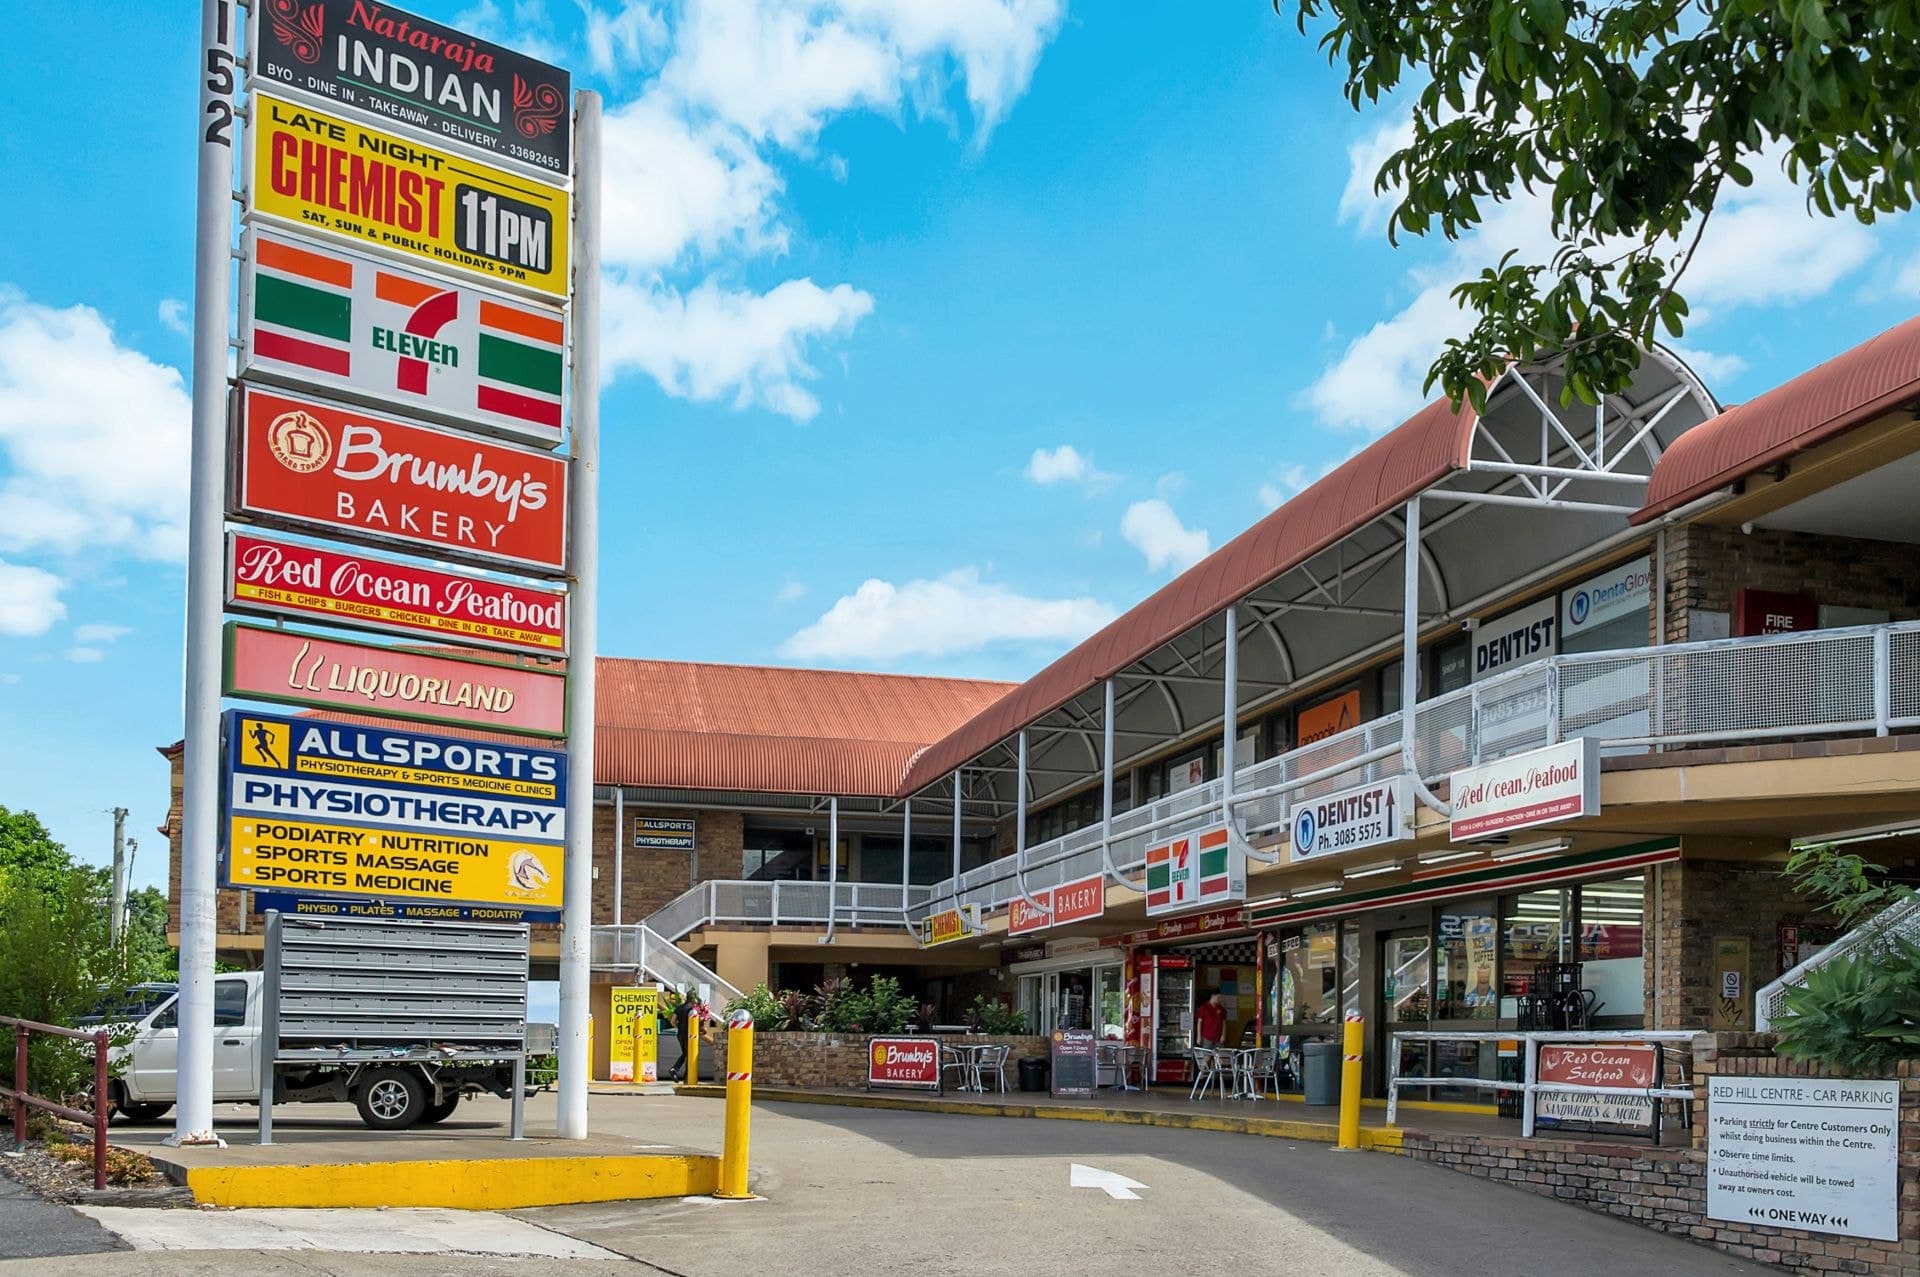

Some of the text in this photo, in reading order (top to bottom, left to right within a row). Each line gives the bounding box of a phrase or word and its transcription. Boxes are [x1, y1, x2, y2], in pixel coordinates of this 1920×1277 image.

[346, 0, 495, 74] Nataraja
[337, 34, 501, 124] INDIAN
[268, 63, 293, 82] BYO
[308, 76, 337, 97] DINE
[342, 88, 355, 101] IN
[369, 96, 429, 125] TAKEAWAY
[443, 122, 497, 148] DELIVERY
[510, 144, 561, 168] 33692455
[272, 106, 444, 171] LATE NIGHT
[271, 131, 546, 270] CHEMIST 11PM
[302, 210, 526, 281] SAT, SUN & PUBLIC HOLIDAYS 9PM
[333, 425, 547, 522] Brumby's
[337, 492, 505, 547] BAKERY
[238, 545, 561, 630] Red Ocean Seafood
[258, 589, 544, 643] FISH & CHIPS BURGERS CHICKEN DINE IN OR TAKE AWAY
[1766, 614, 1793, 629] FIRE
[1477, 618, 1555, 672] DENTIST
[328, 664, 515, 713] LIQUORLAND
[298, 728, 557, 781] ALLSPORTS
[300, 758, 552, 797] PHYSIOTHERAPY & SPORTS MEDICINE CLINICS
[1456, 759, 1577, 810] Red Ocean Seafood
[245, 780, 556, 833] PHYSIOTHERAPY
[1318, 789, 1383, 829] DENTIST
[644, 822, 692, 830] ALLSPORTS
[1472, 822, 1483, 830] CHIPS
[1486, 818, 1504, 827] BURGERS
[1506, 814, 1524, 823] CHICKEN
[256, 824, 489, 858] PODIATRY NUTRITION
[637, 837, 692, 846] PHYSIOTHERAPY
[1319, 822, 1381, 851] Ph. 3085 5575
[255, 845, 459, 874] SPORTS MASSAGE
[255, 866, 453, 893] SPORTS MEDICINE
[297, 903, 524, 920] PHYSIO PILATES MASSAGE PODIATRY
[1058, 887, 1096, 913] BAKERY
[1474, 951, 1494, 963] COFFEE
[616, 1005, 653, 1014] OPEN
[887, 1046, 933, 1069] Brumby's
[1561, 1051, 1630, 1065] Red Ocean
[887, 1068, 924, 1078] BAKERY
[1566, 1067, 1623, 1083] Seafood
[1540, 1092, 1559, 1101] FISH
[1713, 1087, 1733, 1097] RED
[1736, 1088, 1757, 1099] HILL
[1761, 1088, 1803, 1100] CENTRE
[1813, 1090, 1837, 1102] CAR
[1841, 1091, 1893, 1103] PARKING
[1545, 1103, 1641, 1120] SANDWICHES & MORE
[1720, 1117, 1891, 1136] Parking strictly for Centre Customers Only
[1720, 1132, 1875, 1149] whilst doing business within the Centre.
[1719, 1150, 1795, 1163] Observe time limits.
[1718, 1168, 1855, 1187] Unauthorised vehicle will be towed
[1718, 1183, 1735, 1193] away
[1747, 1187, 1774, 1195] owners
[1776, 1189, 1795, 1197] cost.
[1769, 1208, 1827, 1225] ONE WAY
